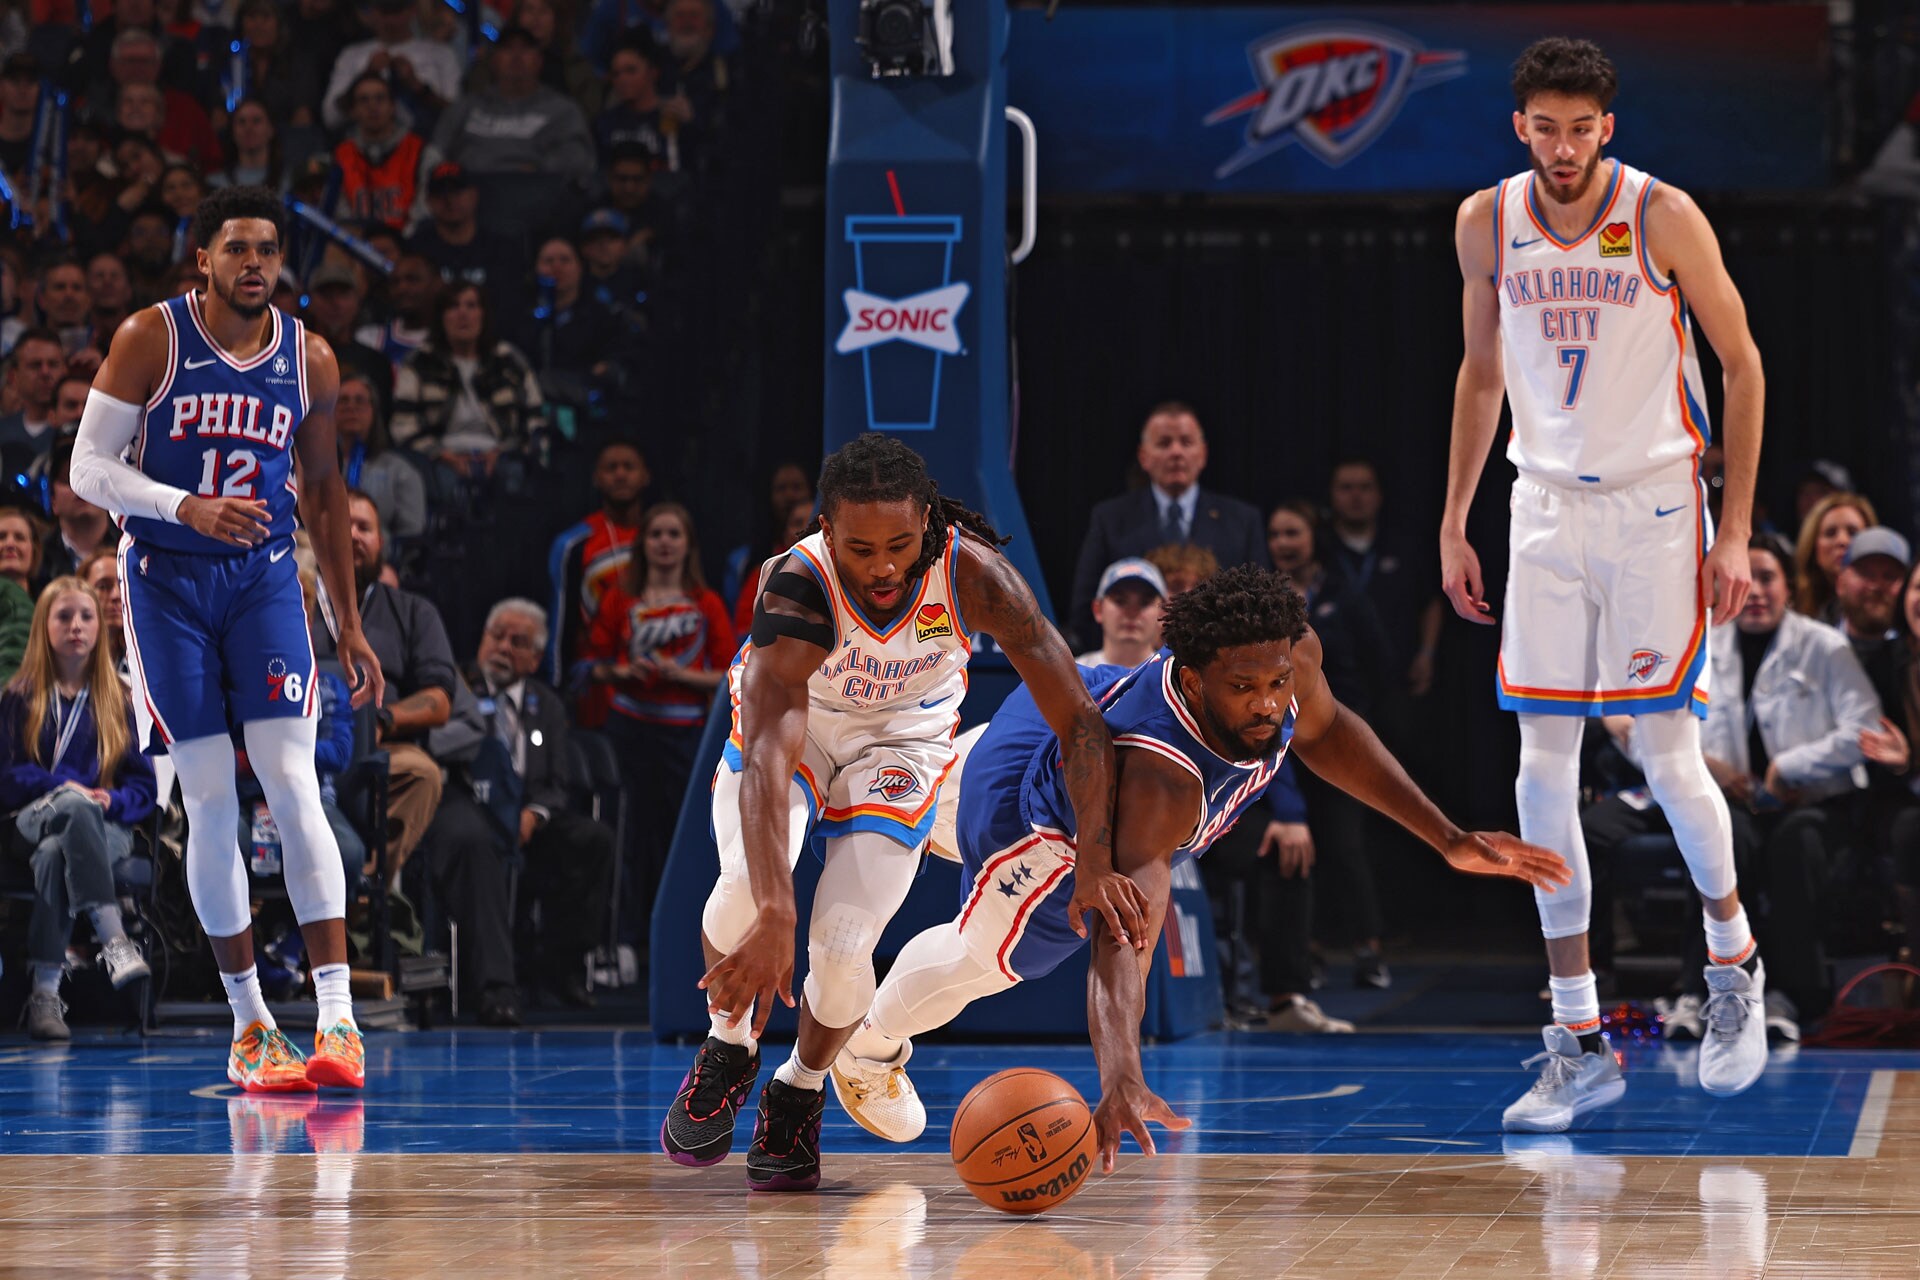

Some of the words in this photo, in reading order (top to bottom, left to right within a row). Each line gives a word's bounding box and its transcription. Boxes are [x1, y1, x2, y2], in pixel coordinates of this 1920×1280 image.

[1255, 50, 1381, 139] OKC
[1505, 267, 1642, 308] OKLAHOMA
[854, 308, 948, 332] SONIC
[1540, 308, 1600, 341] CITY
[1557, 345, 1589, 410] 7
[169, 393, 294, 450] PHILA
[197, 448, 260, 500] 12
[819, 647, 947, 680] OKLAHOM
[267, 673, 303, 702] 76
[842, 676, 905, 700] CITY
[869, 776, 911, 792] OKC
[1000, 1152, 1091, 1202] Wilson
